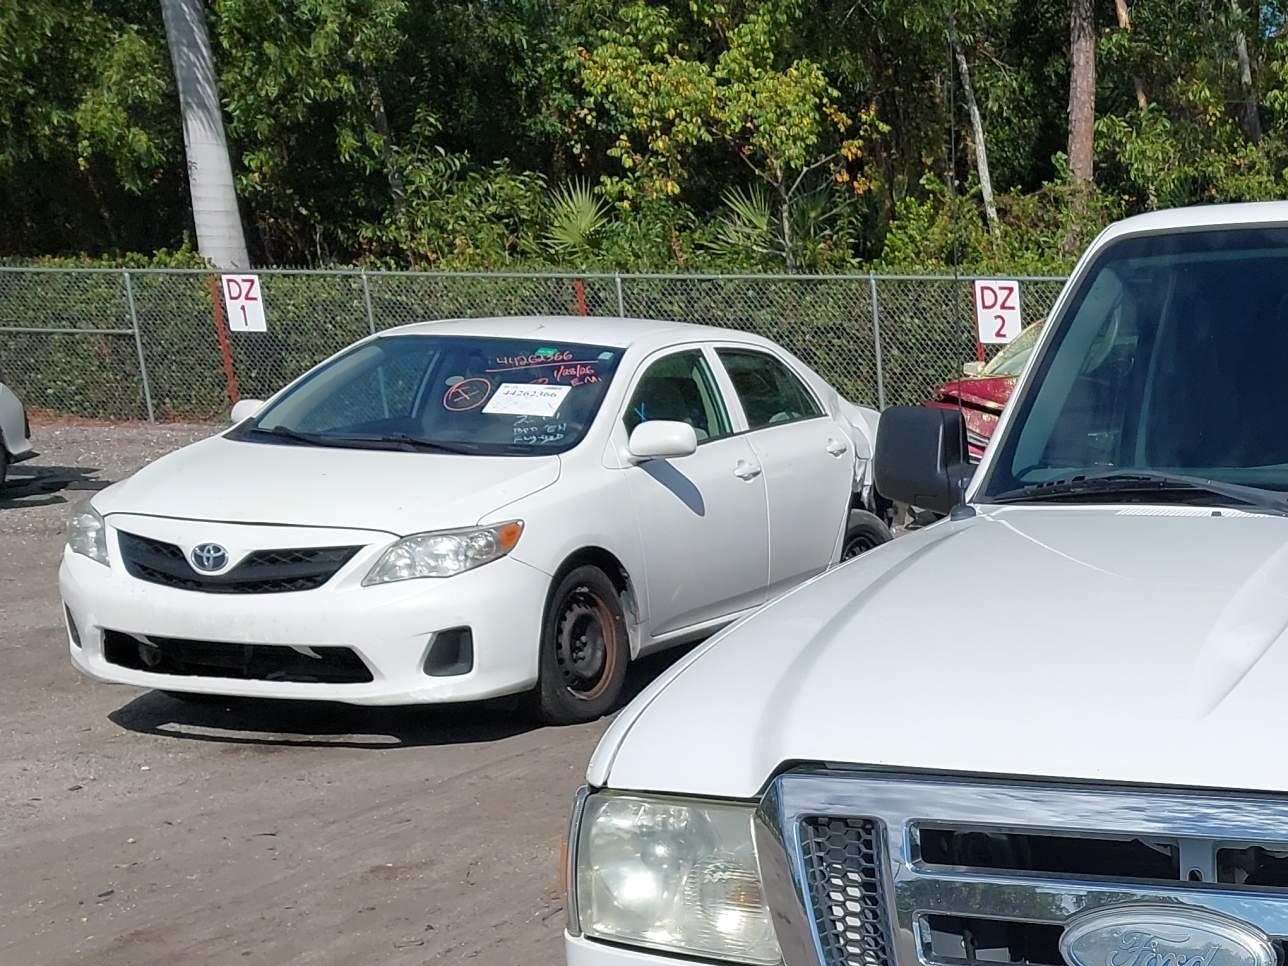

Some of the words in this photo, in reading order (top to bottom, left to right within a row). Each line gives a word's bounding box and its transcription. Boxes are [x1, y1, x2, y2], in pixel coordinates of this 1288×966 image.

[226, 278, 258, 301] DZ
[980, 286, 1016, 310] DZ
[240, 304, 248, 327] 1
[994, 314, 1007, 338] 2
